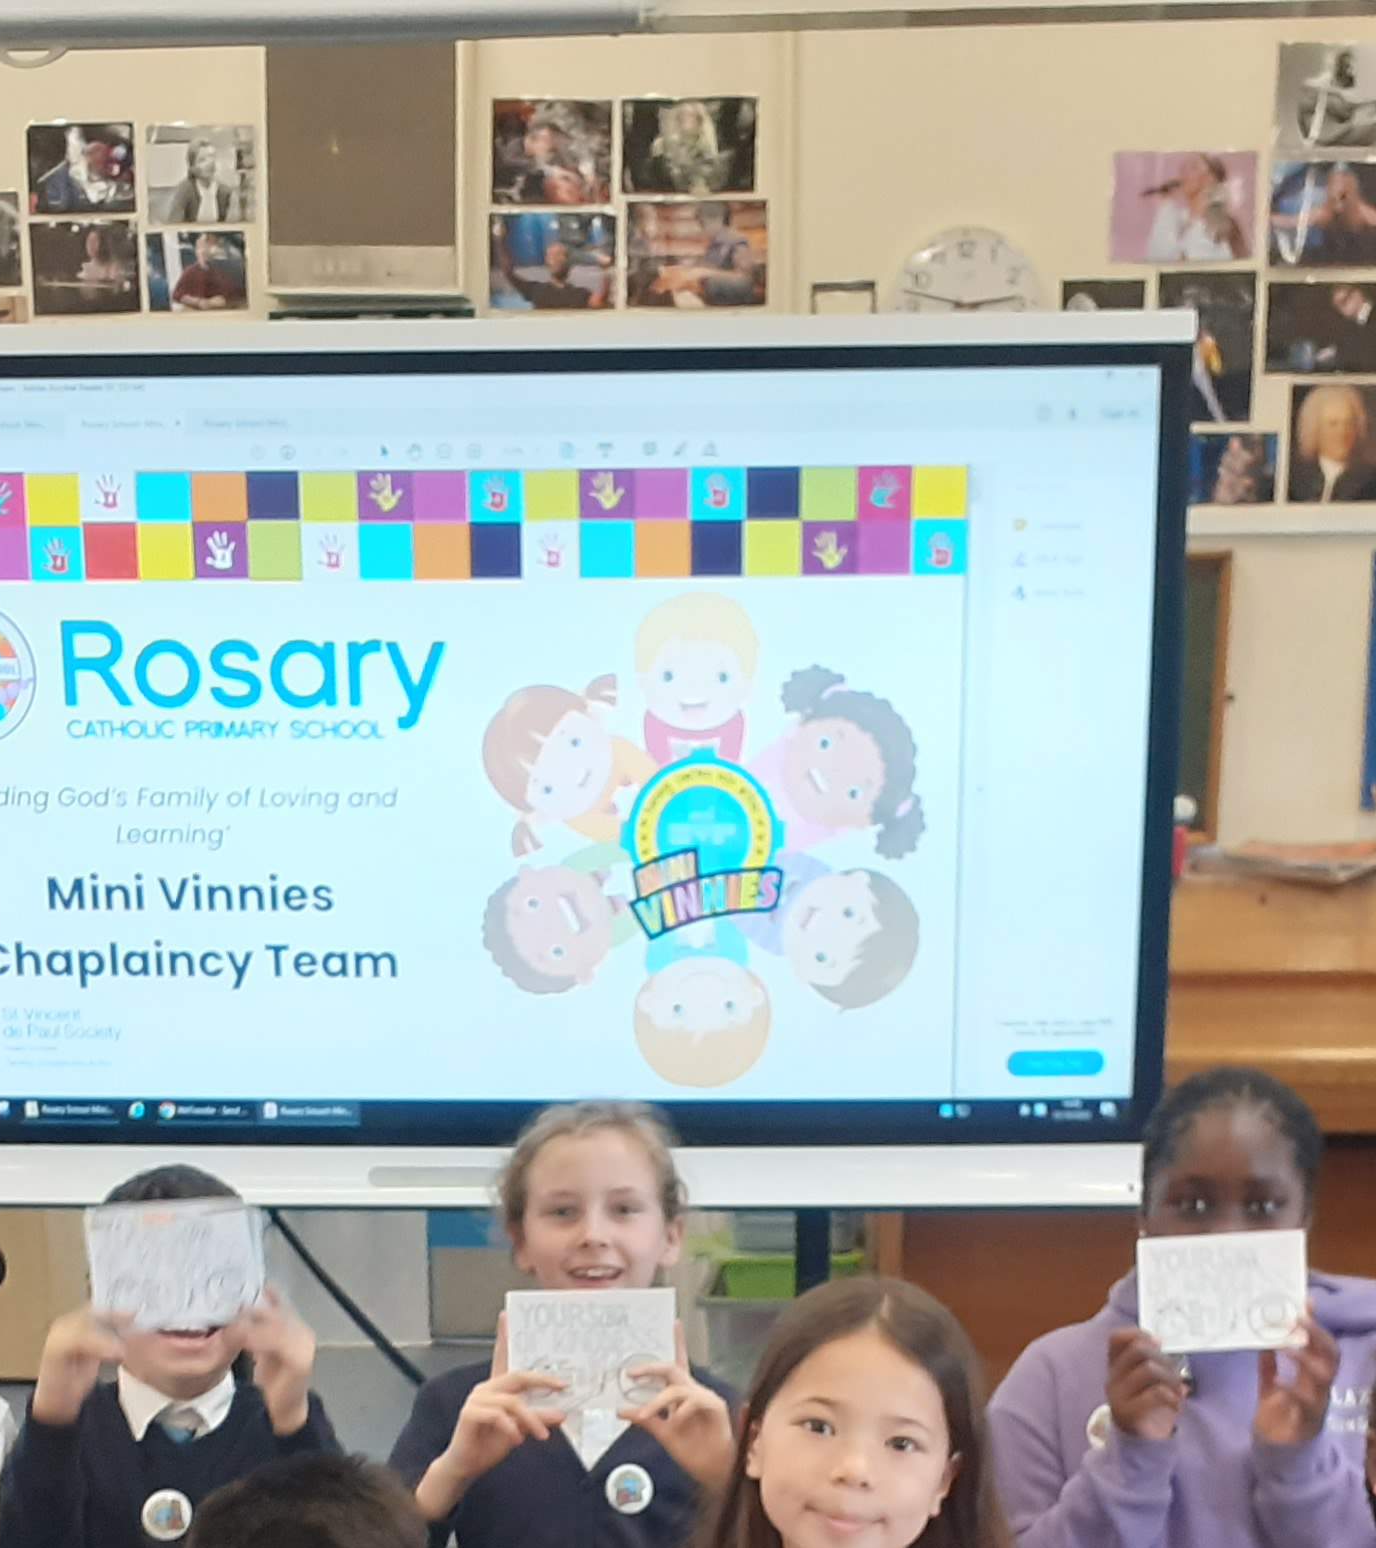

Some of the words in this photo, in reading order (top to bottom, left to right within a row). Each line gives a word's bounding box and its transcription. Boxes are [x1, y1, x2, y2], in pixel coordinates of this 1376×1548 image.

[60, 619, 445, 729] Rosary
[67, 720, 175, 739] CATHOLIC
[185, 719, 279, 739] PRIMARY
[290, 719, 385, 739] SCHOOL
[57, 786, 128, 808] God's
[136, 786, 219, 814] Family
[226, 786, 252, 808] of
[258, 786, 339, 814] Loving
[347, 786, 399, 808] and
[45, 873, 145, 912] Mini
[158, 873, 336, 912] Vinnies
[631, 869, 782, 939] VINNIES
[265, 943, 399, 979] Team
